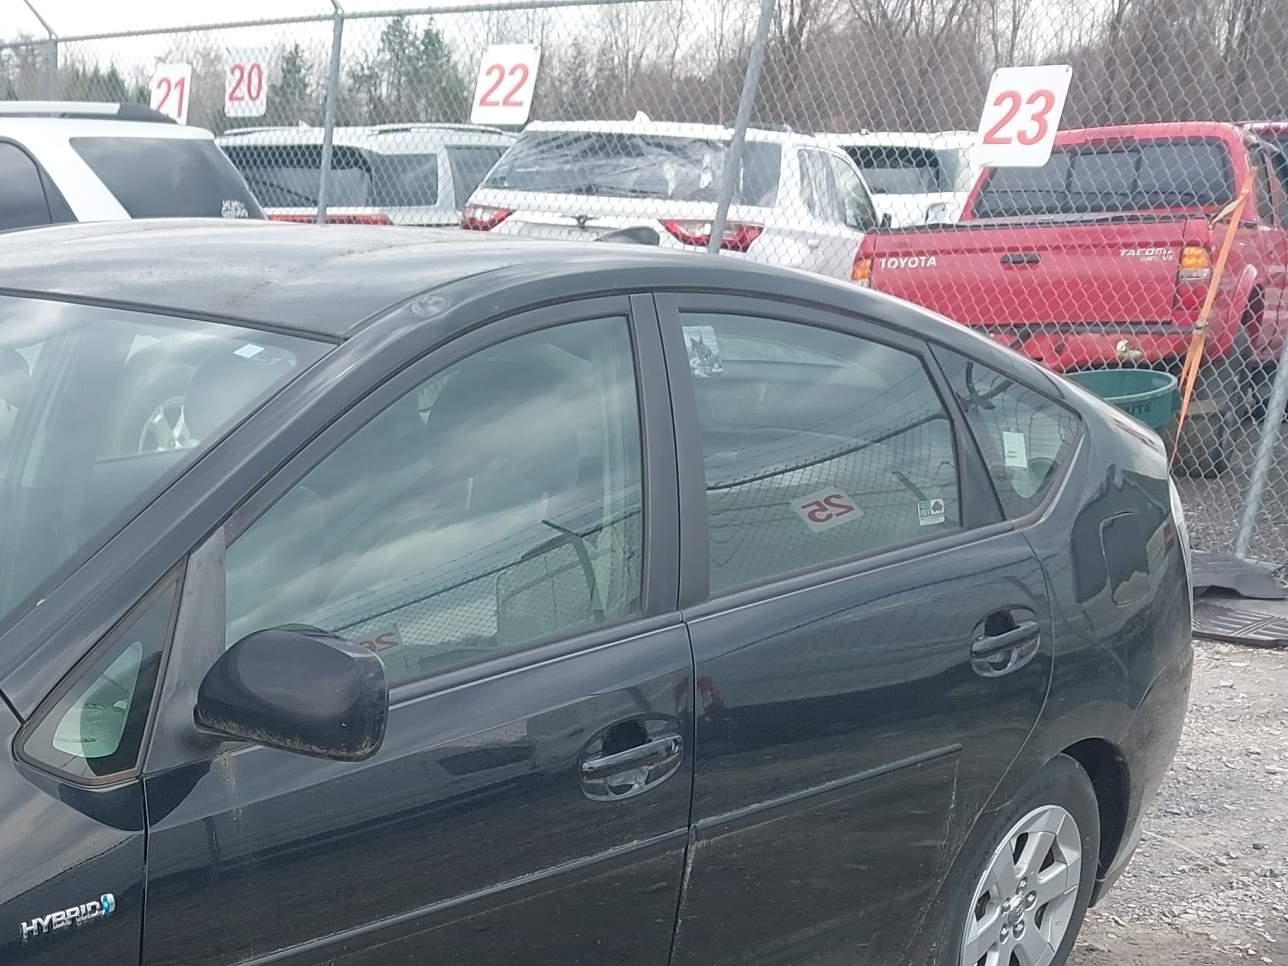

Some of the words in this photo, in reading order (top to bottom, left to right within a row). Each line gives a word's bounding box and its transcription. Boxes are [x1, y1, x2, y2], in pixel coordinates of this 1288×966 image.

[156, 77, 186, 119] 21
[229, 63, 263, 102] 20
[479, 63, 529, 107] 22
[983, 89, 1056, 146] 23
[880, 256, 937, 269] TOYOTA
[21, 901, 101, 939] HYBRID
